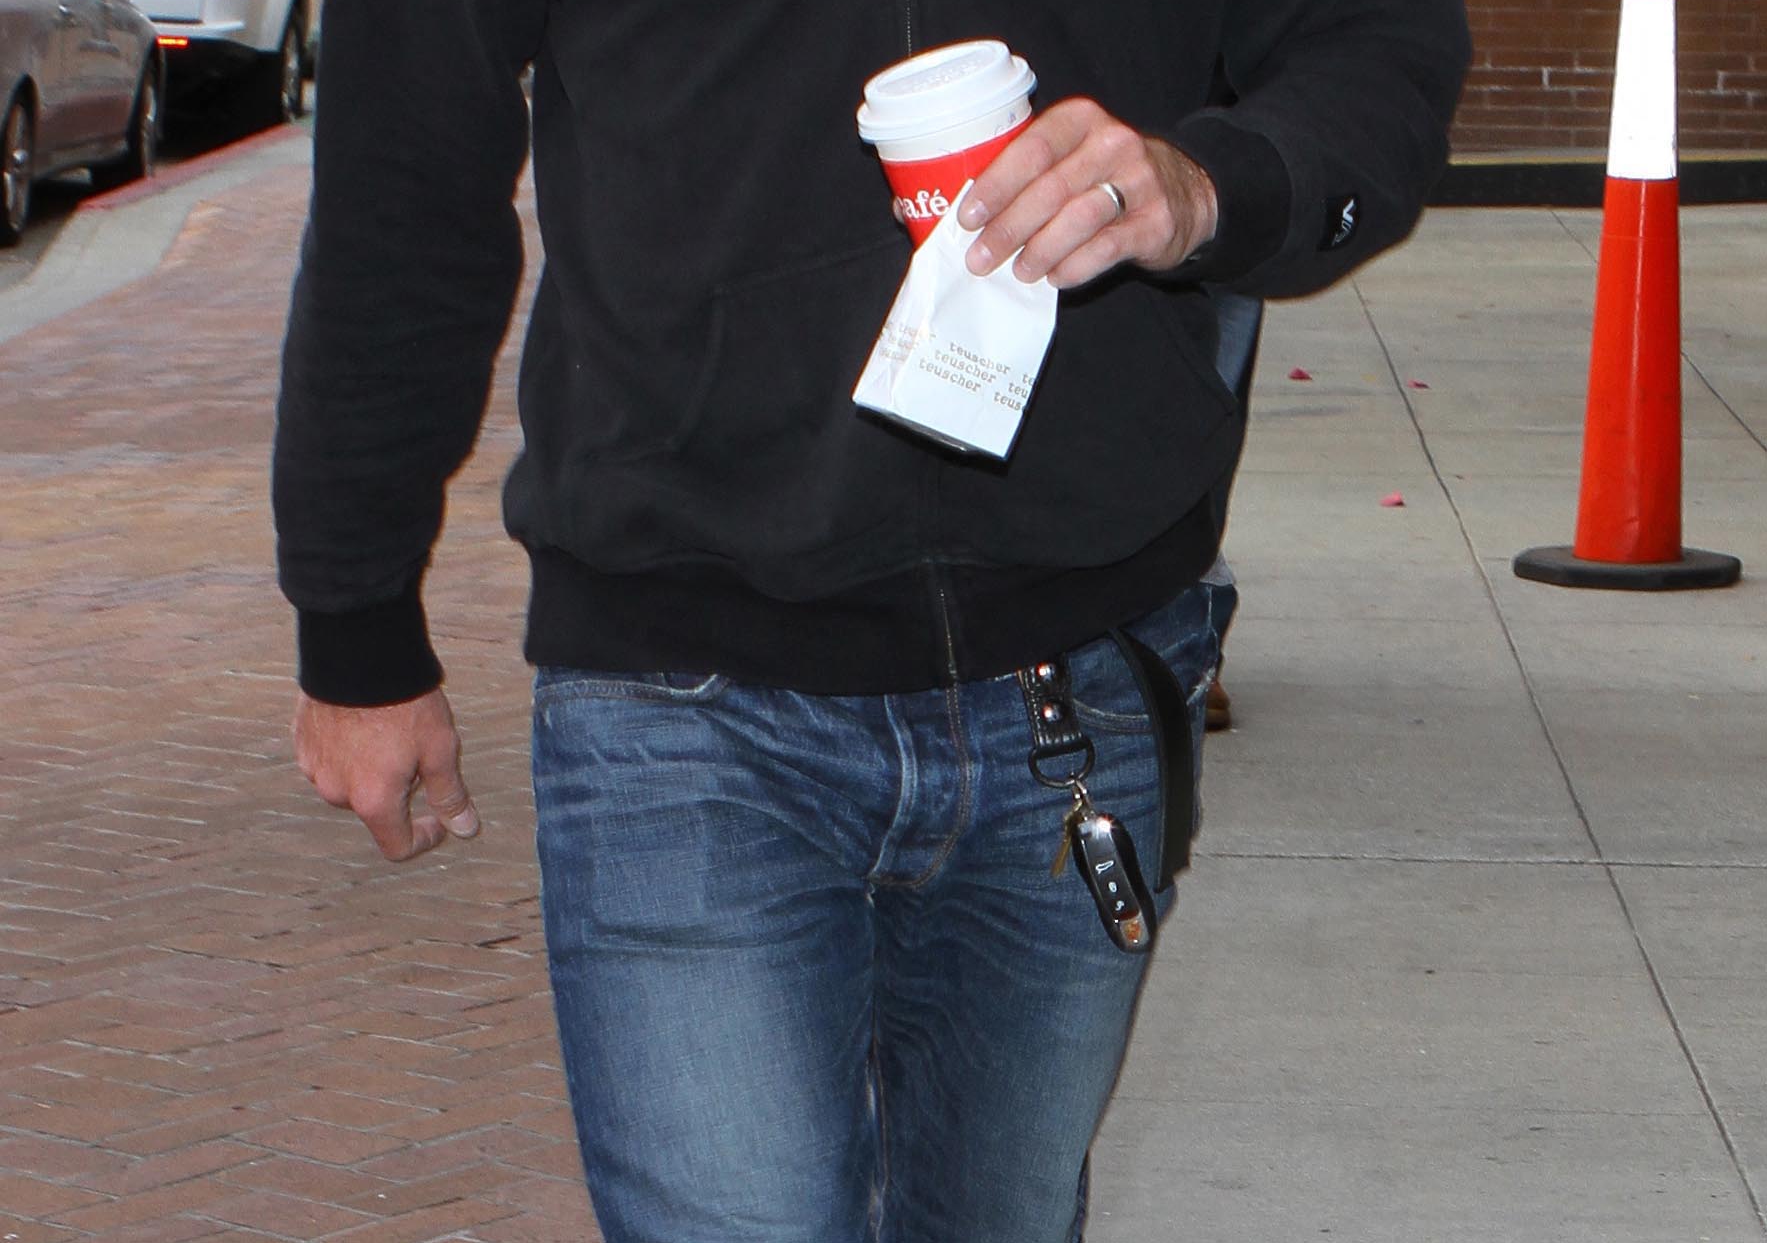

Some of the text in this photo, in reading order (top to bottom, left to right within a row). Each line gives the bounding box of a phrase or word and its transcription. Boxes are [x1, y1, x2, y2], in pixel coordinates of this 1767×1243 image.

[934, 349, 996, 383] teuscher
[949, 342, 1011, 375] teuscher
[919, 358, 1024, 412] teuscher teus
